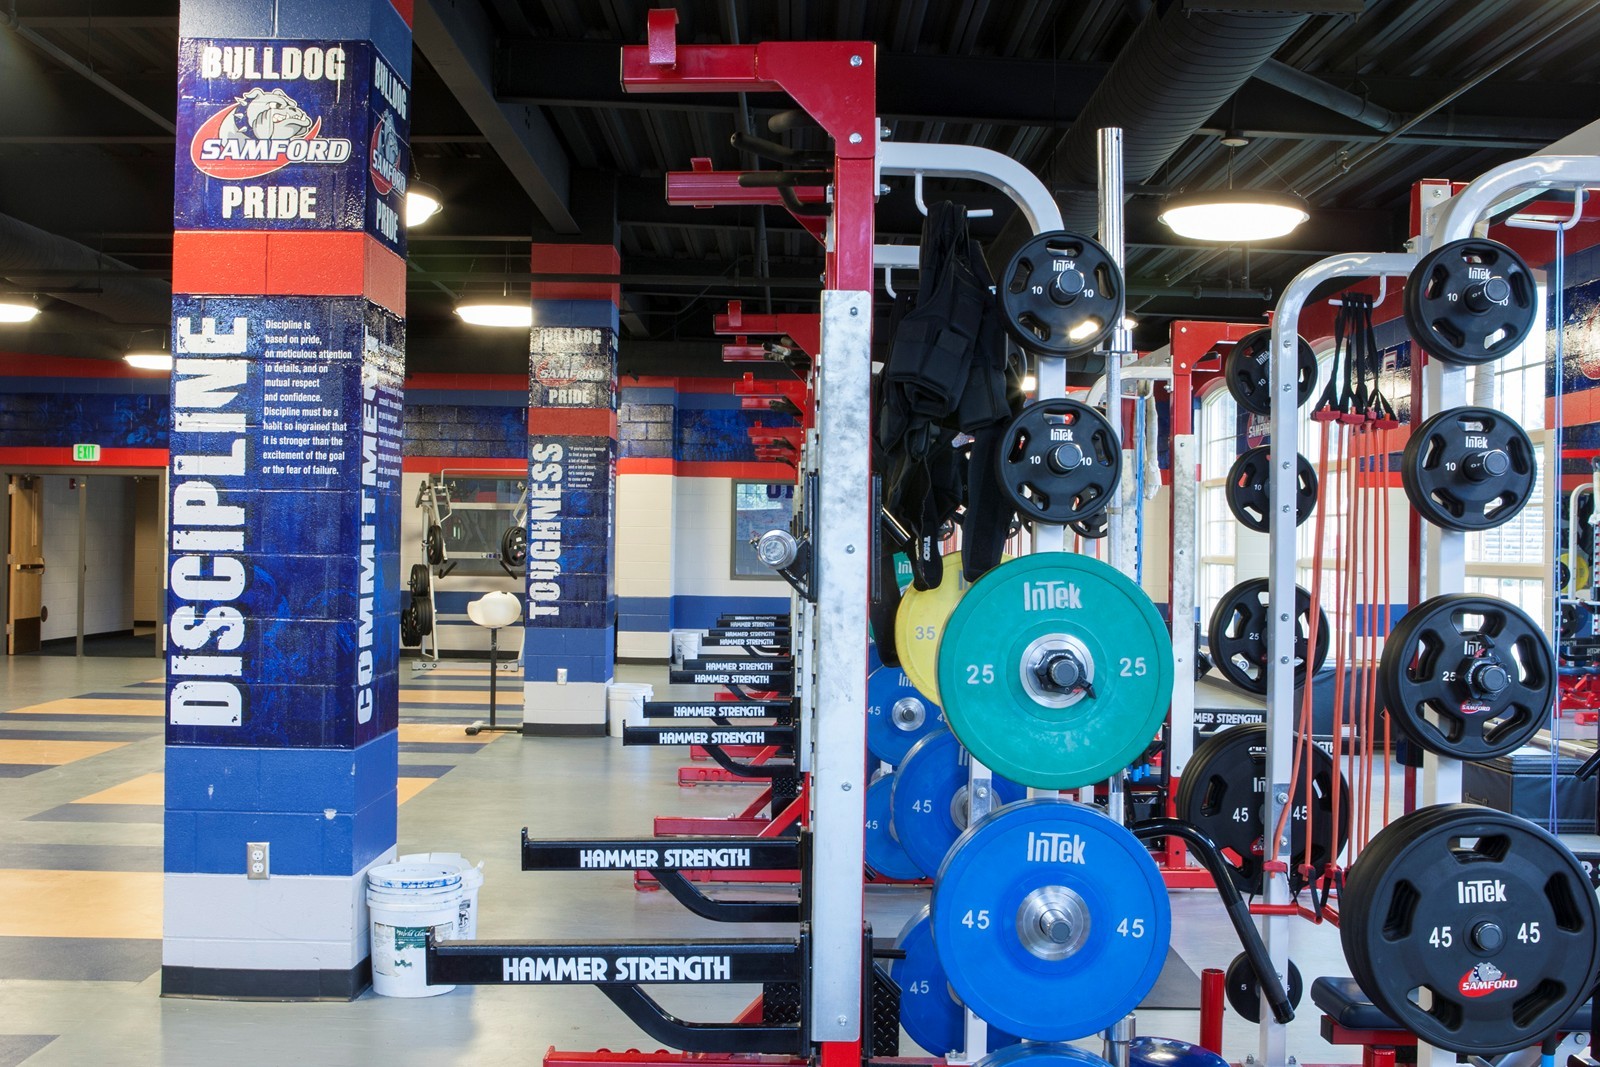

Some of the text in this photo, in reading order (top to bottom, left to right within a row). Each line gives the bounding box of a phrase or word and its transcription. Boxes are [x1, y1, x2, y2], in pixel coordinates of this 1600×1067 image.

[201, 46, 345, 80] BULLDOG
[374, 58, 407, 120] BULLDOG
[201, 138, 350, 161] SAMFORD
[372, 148, 406, 195] SAMFORD
[222, 186, 317, 219] PRIDE
[376, 199, 399, 244] PRIDE
[1053, 259, 1076, 272] InTek
[1468, 267, 1491, 280] InTek
[1031, 286, 1043, 295] 10
[1083, 289, 1094, 298] 10
[1447, 292, 1458, 302] 10
[265, 320, 311, 330] Discipline is
[265, 335, 323, 345] based on pride,
[264, 350, 352, 359] on meticulous attention
[264, 363, 328, 374] to details, and on
[264, 378, 320, 389] mutual respect
[1258, 378, 1267, 387] 10
[264, 393, 323, 402] and confidence.
[548, 389, 591, 404] PRIDE
[264, 407, 300, 418] Discipline
[302, 408, 321, 416] must
[322, 408, 332, 416] be
[263, 421, 282, 430] habit
[295, 422, 330, 432] ingrained
[332, 422, 347, 431] that
[263, 436, 343, 447] it is stronger than the
[1050, 429, 1074, 442] InTek
[1465, 436, 1488, 449] InTek
[77, 445, 95, 459] EXIT
[263, 451, 345, 462] excitement of the goal
[1029, 455, 1041, 465] 10
[1081, 456, 1092, 466] 10
[1445, 462, 1456, 471] 10
[272, 465, 285, 473] the
[286, 465, 301, 474] fear
[303, 465, 311, 474] of
[312, 465, 339, 474] failure.
[170, 317, 248, 727] DISCIPLINE
[529, 443, 563, 620] TOUGHNESS
[898, 561, 912, 574] InT
[1024, 580, 1083, 611] InTek
[915, 626, 936, 641] 35
[1249, 632, 1260, 640] 25
[1464, 640, 1482, 655] InT
[739, 663, 773, 671] STRENGTH
[1119, 657, 1147, 678] 25
[694, 674, 770, 684] HAMMER STRENGTH
[966, 664, 995, 685] 25
[1442, 671, 1456, 682] 25
[673, 706, 765, 717] HAMMER STRENGTH
[867, 706, 881, 715] 45
[1194, 712, 1262, 724] MER STRENGTH
[659, 732, 765, 744] HAMMER STRENGTH
[912, 800, 932, 814] 45
[1292, 806, 1308, 821] 45
[1232, 807, 1249, 822] 45
[865, 821, 878, 830] 45
[1026, 831, 1086, 865] InTek
[579, 848, 750, 868] HAMMER STRENGTH
[1457, 880, 1507, 904] InTek
[962, 909, 991, 930] 45
[1116, 918, 1145, 938] 45
[1517, 922, 1541, 943] 45
[1429, 926, 1453, 948] 45
[502, 955, 731, 981] HAMMER STRENGTH
[909, 980, 930, 995] 45
[1462, 979, 1518, 991] SAMFORD
